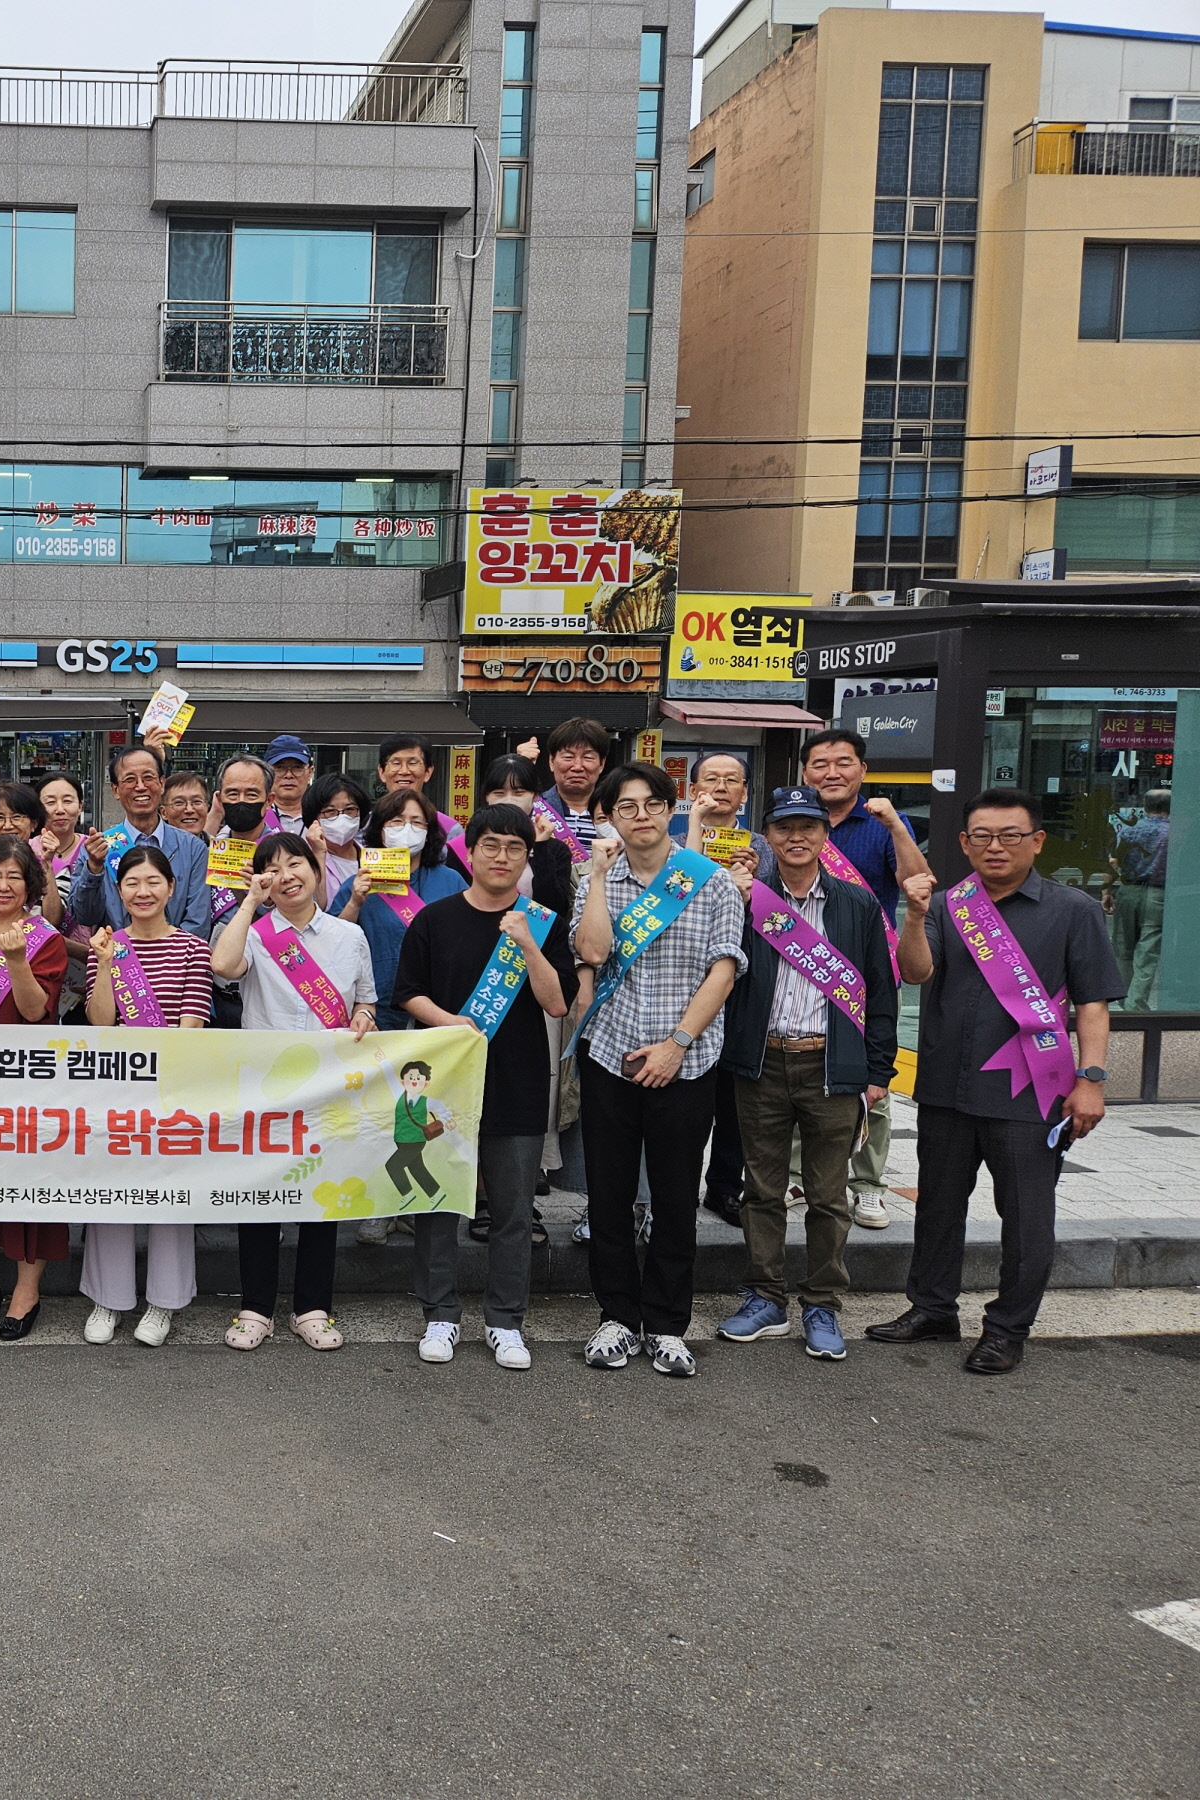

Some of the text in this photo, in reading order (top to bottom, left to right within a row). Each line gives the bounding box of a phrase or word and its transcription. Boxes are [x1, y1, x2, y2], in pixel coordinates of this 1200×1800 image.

[257, 515, 318, 535] 麻辣烫
[354, 518, 436, 538] 各种炒饭
[17, 538, 116, 557] 010-2355-9158
[478, 541, 634, 585] 양꼬치
[477, 616, 587, 629] 010-2355-9158
[682, 607, 800, 648] OK 열쇠
[55, 638, 158, 674] GS25
[484, 663, 503, 675] 낙타
[524, 645, 639, 696] 7080
[708, 655, 795, 669] 010-3841-1518
[819, 641, 897, 670] BUS STOP
[1129, 688, 1166, 696] 746-3733
[1104, 718, 1174, 733] 사진 잘 찍는
[212, 840, 226, 851] NO
[701, 829, 716, 840] NO
[365, 851, 379, 861] NO
[619, 893, 662, 933] 건강한
[621, 914, 664, 959] 행복한
[954, 905, 995, 962] 청소년은
[784, 941, 833, 984] 건강한
[810, 942, 858, 986] 행복한
[110, 965, 140, 1020] 청소년은
[125, 966, 147, 998] 관심과
[312, 975, 339, 1006] 관심과
[469, 967, 504, 1018] 청소년
[298, 980, 336, 1025] 청소년은
[482, 992, 508, 1025] 경주
[1020, 985, 1057, 1025] 자란다
[66, 1048, 159, 1083] 캠페인
[107, 1108, 323, 1157] 밝습니다.
[209, 1188, 304, 1207] 청바지봉사단
